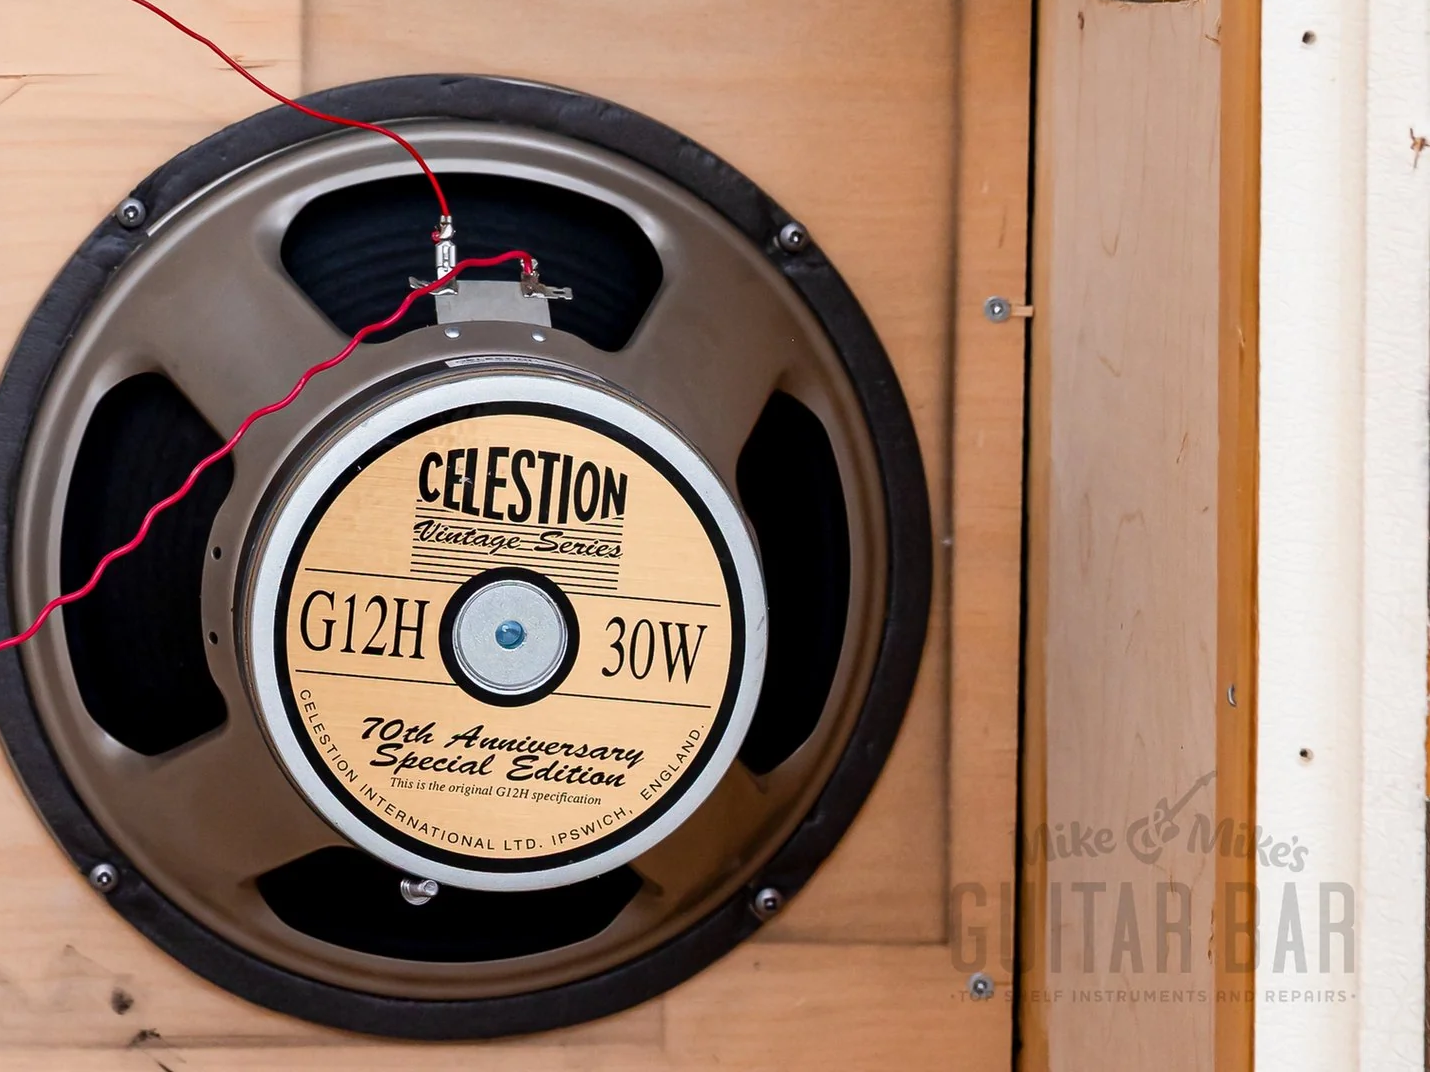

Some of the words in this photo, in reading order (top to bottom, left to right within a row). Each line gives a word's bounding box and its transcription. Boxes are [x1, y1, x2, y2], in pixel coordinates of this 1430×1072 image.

[418, 446, 628, 524] CELESTION
[413, 519, 520, 554] Vintage
[533, 531, 623, 559] Series
[300, 590, 431, 660] G12H
[601, 616, 708, 684] 30W
[361, 717, 436, 744] 70th
[443, 724, 644, 769] Anniversary
[369, 743, 496, 775] Special
[505, 755, 626, 788] Edition
[299, 689, 359, 783] CELESTION
[359, 783, 495, 851] INTERNATIONAL
[504, 838, 543, 851] LTD.
[551, 807, 633, 846] IPSWICH,
[640, 724, 705, 801] ENGLAND.
[390, 777, 413, 789] This
[416, 779, 426, 790] is
[428, 780, 446, 792] the
[448, 783, 492, 797] original
[495, 786, 530, 800] G12H
[531, 792, 602, 806] specification
